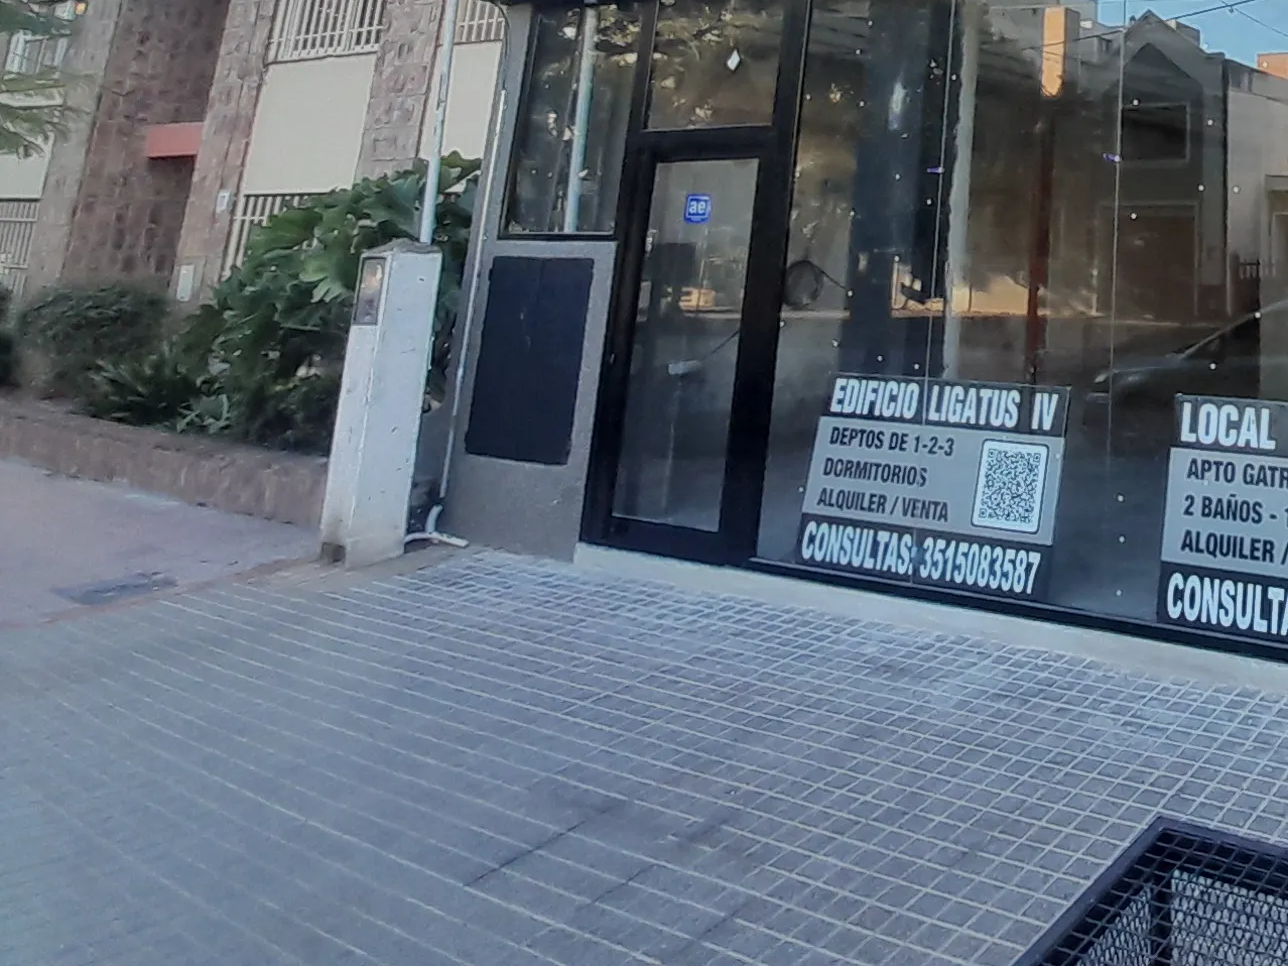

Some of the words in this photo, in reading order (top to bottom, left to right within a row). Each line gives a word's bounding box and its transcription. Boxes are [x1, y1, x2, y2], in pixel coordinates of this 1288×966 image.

[829, 377, 920, 420] EDIFICIO
[928, 384, 1021, 429] LIGATUS
[1031, 392, 1059, 431] IV
[829, 426, 884, 450] DEPTOS
[888, 431, 908, 452] DE
[913, 435, 955, 456] 1-2-3
[1180, 401, 1276, 450] LOCAL
[823, 457, 928, 487] DORMITORIOS
[1187, 457, 1236, 484] APTO
[816, 487, 887, 515] ALQUILER
[902, 498, 948, 522] VENTA
[1183, 495, 1195, 517] 2
[1201, 493, 1263, 524] BAÑOS
[801, 521, 913, 576] CONSULTAS:
[920, 537, 1042, 594] 3515083587
[1180, 530, 1275, 564] ALQUILER
